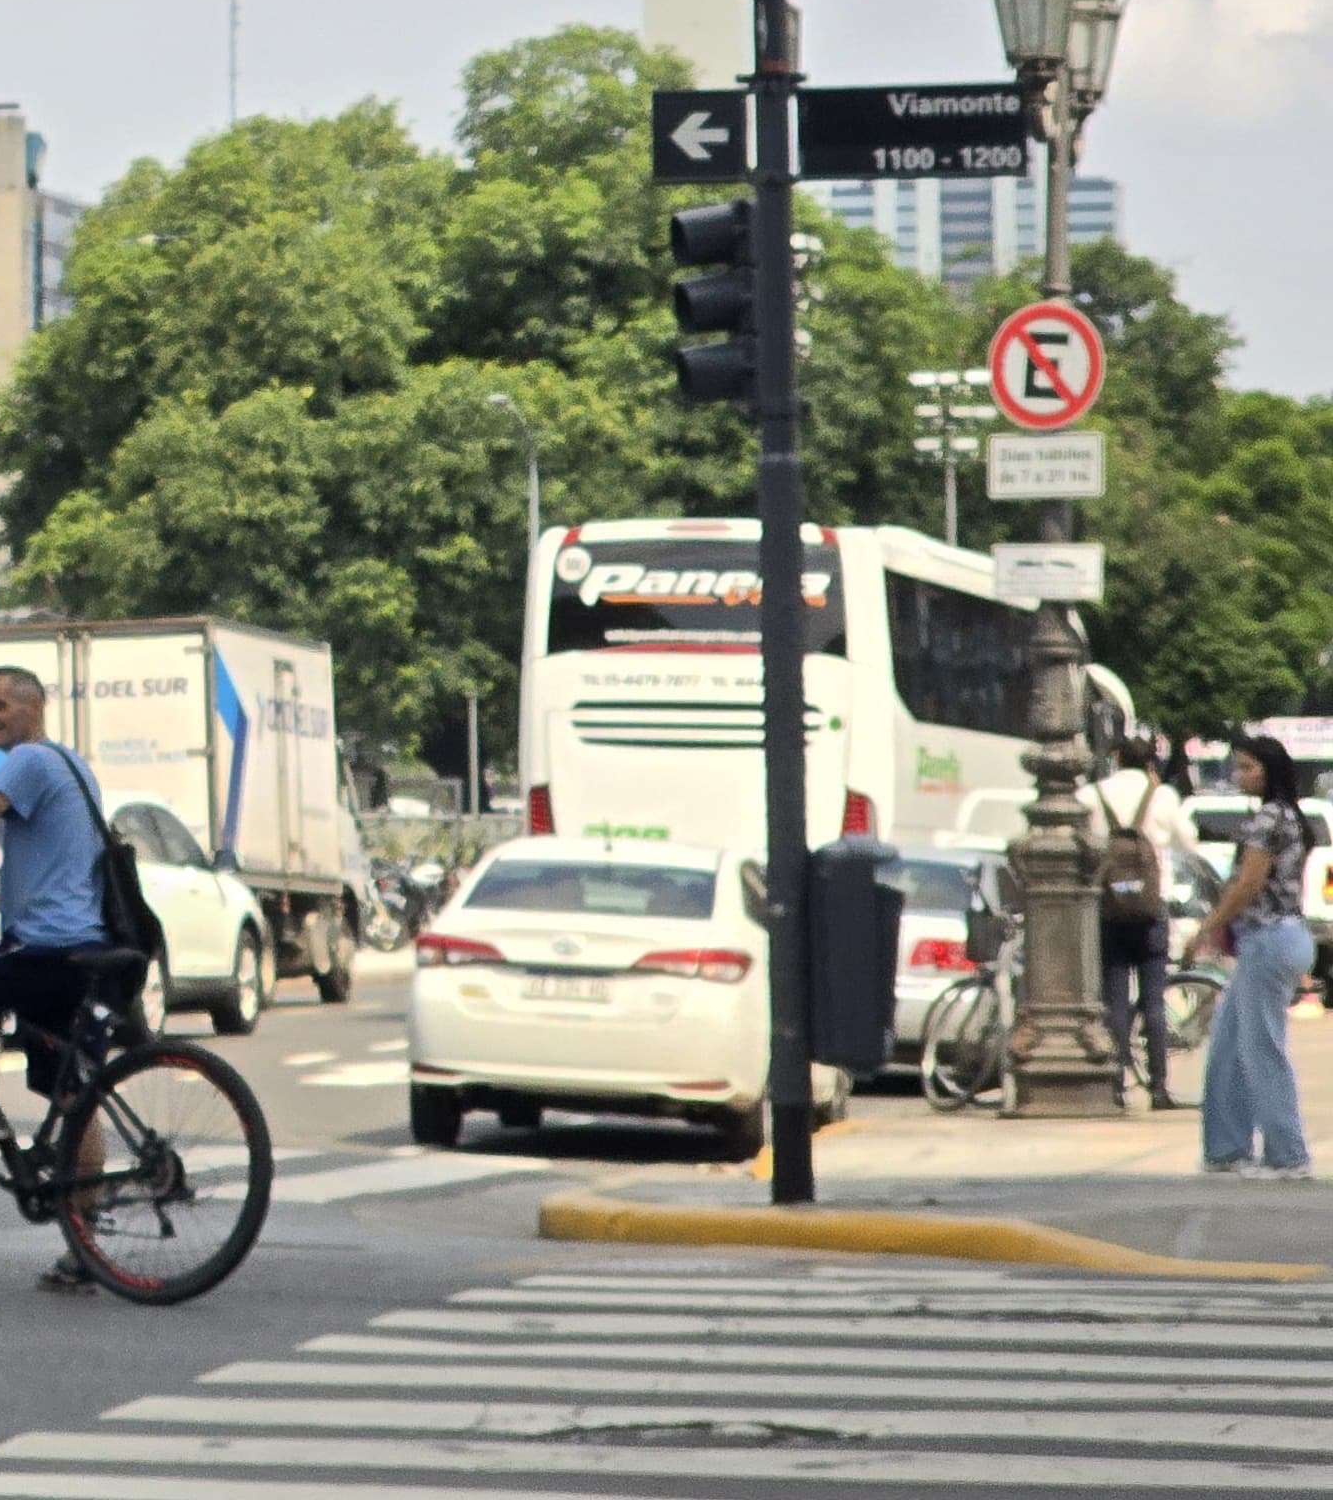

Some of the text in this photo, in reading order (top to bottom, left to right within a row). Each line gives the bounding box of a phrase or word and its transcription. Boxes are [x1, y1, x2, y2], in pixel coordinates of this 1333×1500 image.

[887, 92, 1022, 116] Viamonte
[873, 147, 936, 171] 1100
[959, 145, 1023, 169] 1200
[94, 680, 137, 699] DEL
[142, 676, 189, 697] SUR
